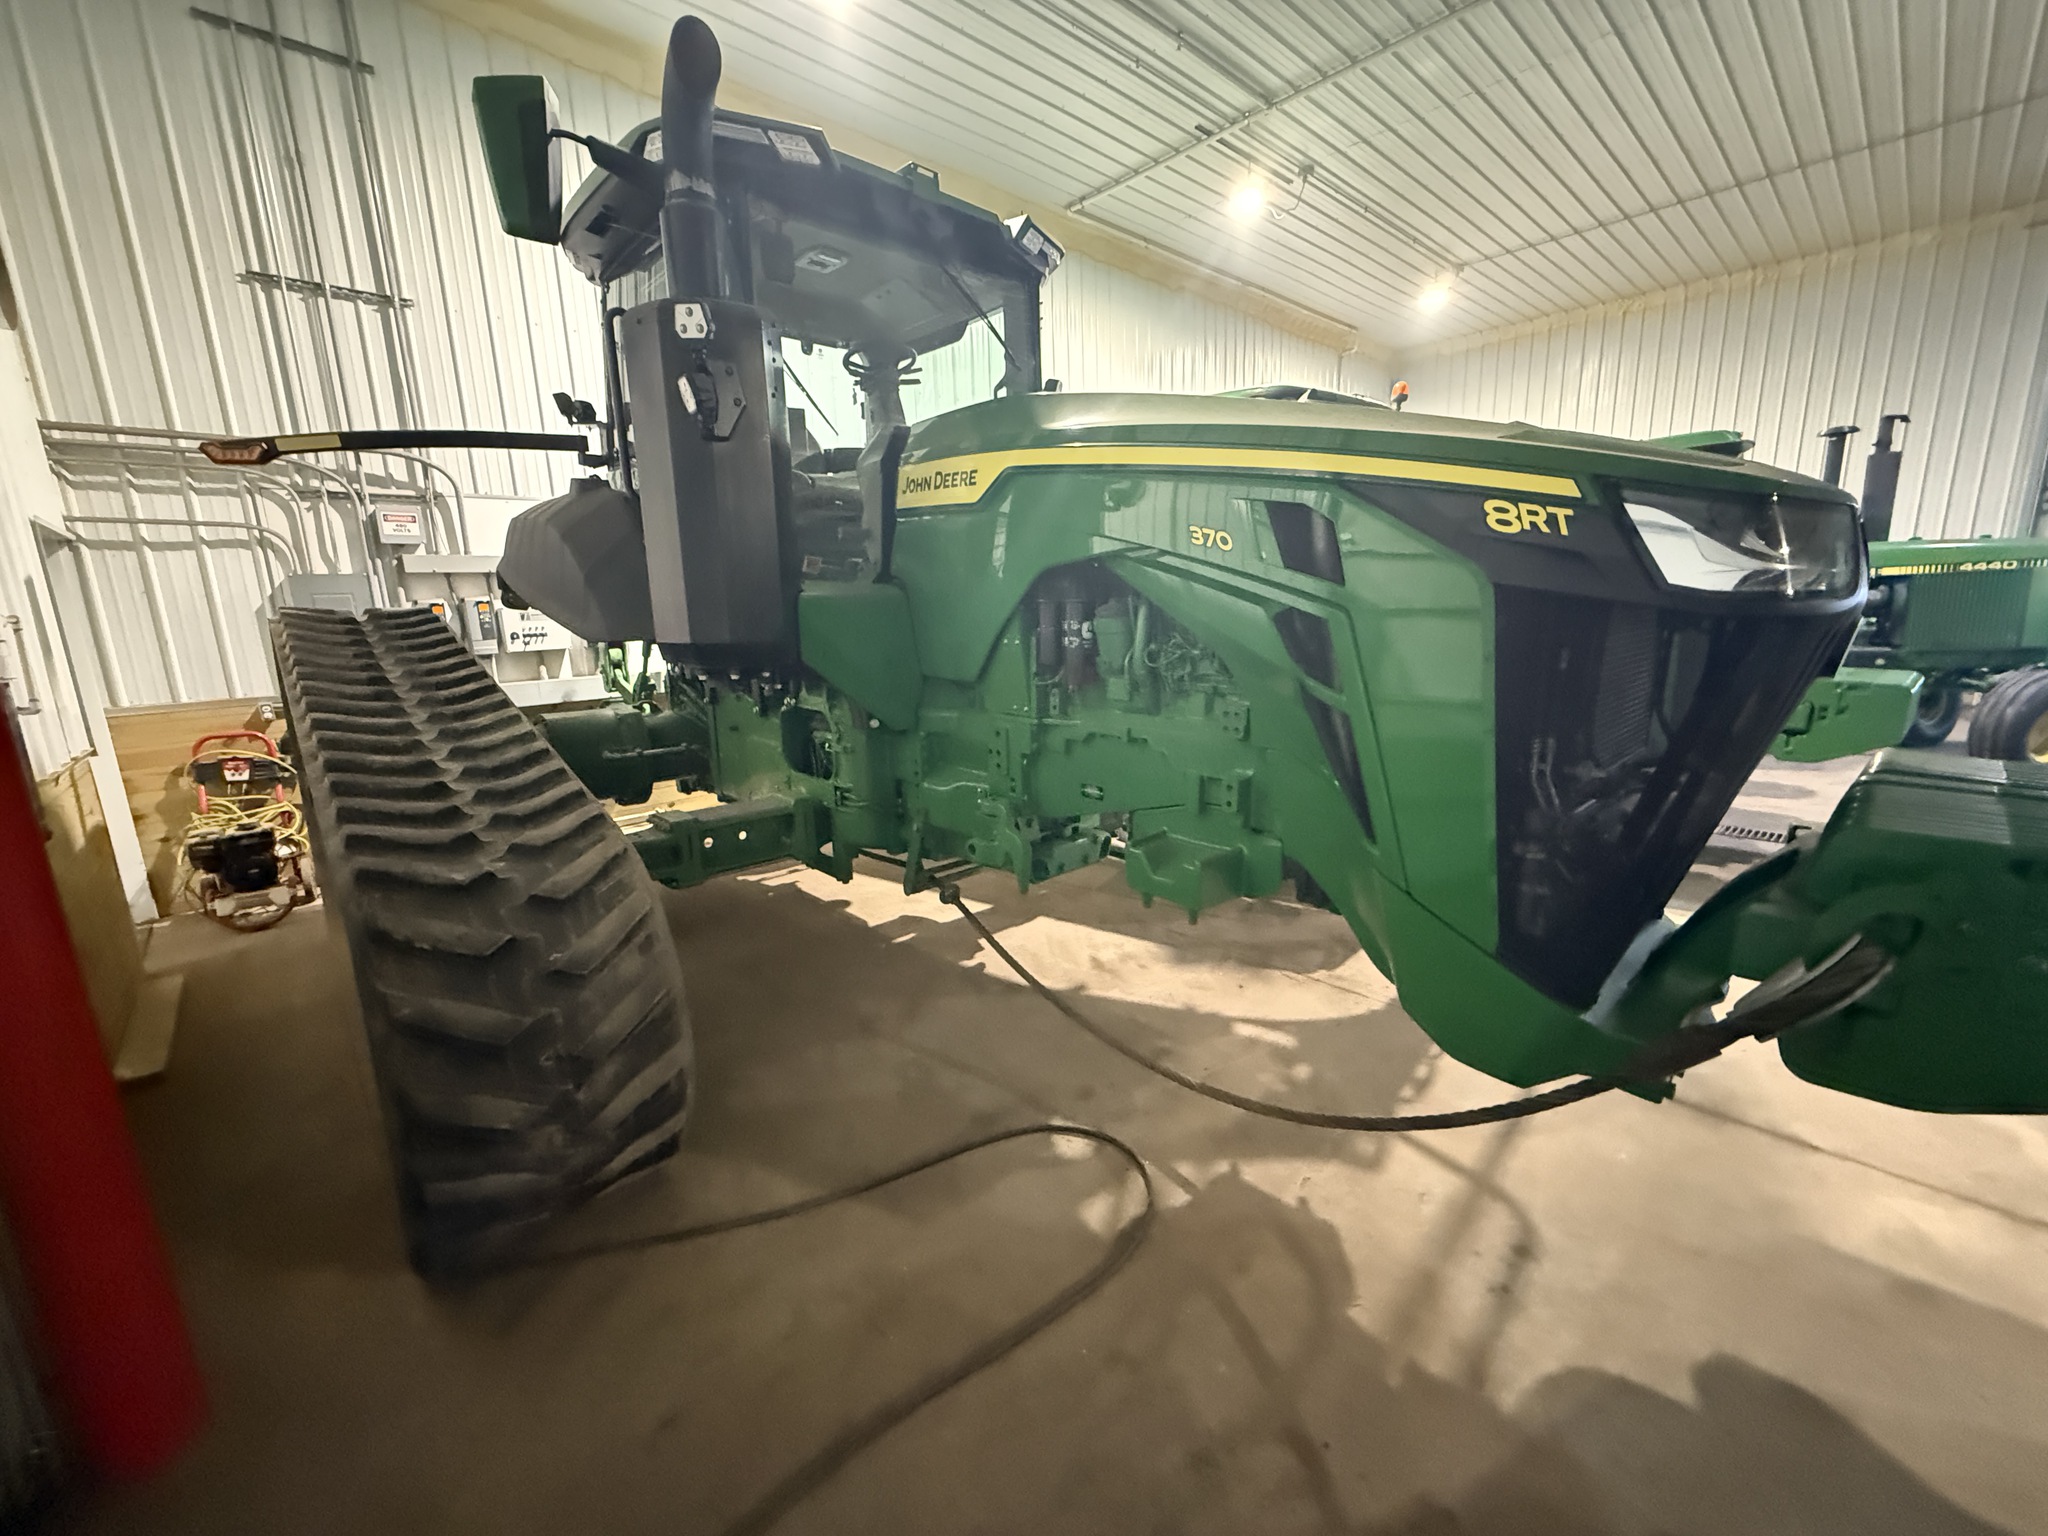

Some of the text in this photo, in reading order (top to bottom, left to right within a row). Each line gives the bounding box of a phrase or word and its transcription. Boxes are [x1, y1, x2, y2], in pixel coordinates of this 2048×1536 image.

[902, 469, 978, 495] JOHN DEERE
[1483, 498, 1575, 537] 8RT
[1188, 525, 1233, 552] 370
[1959, 560, 2018, 572] 4440
